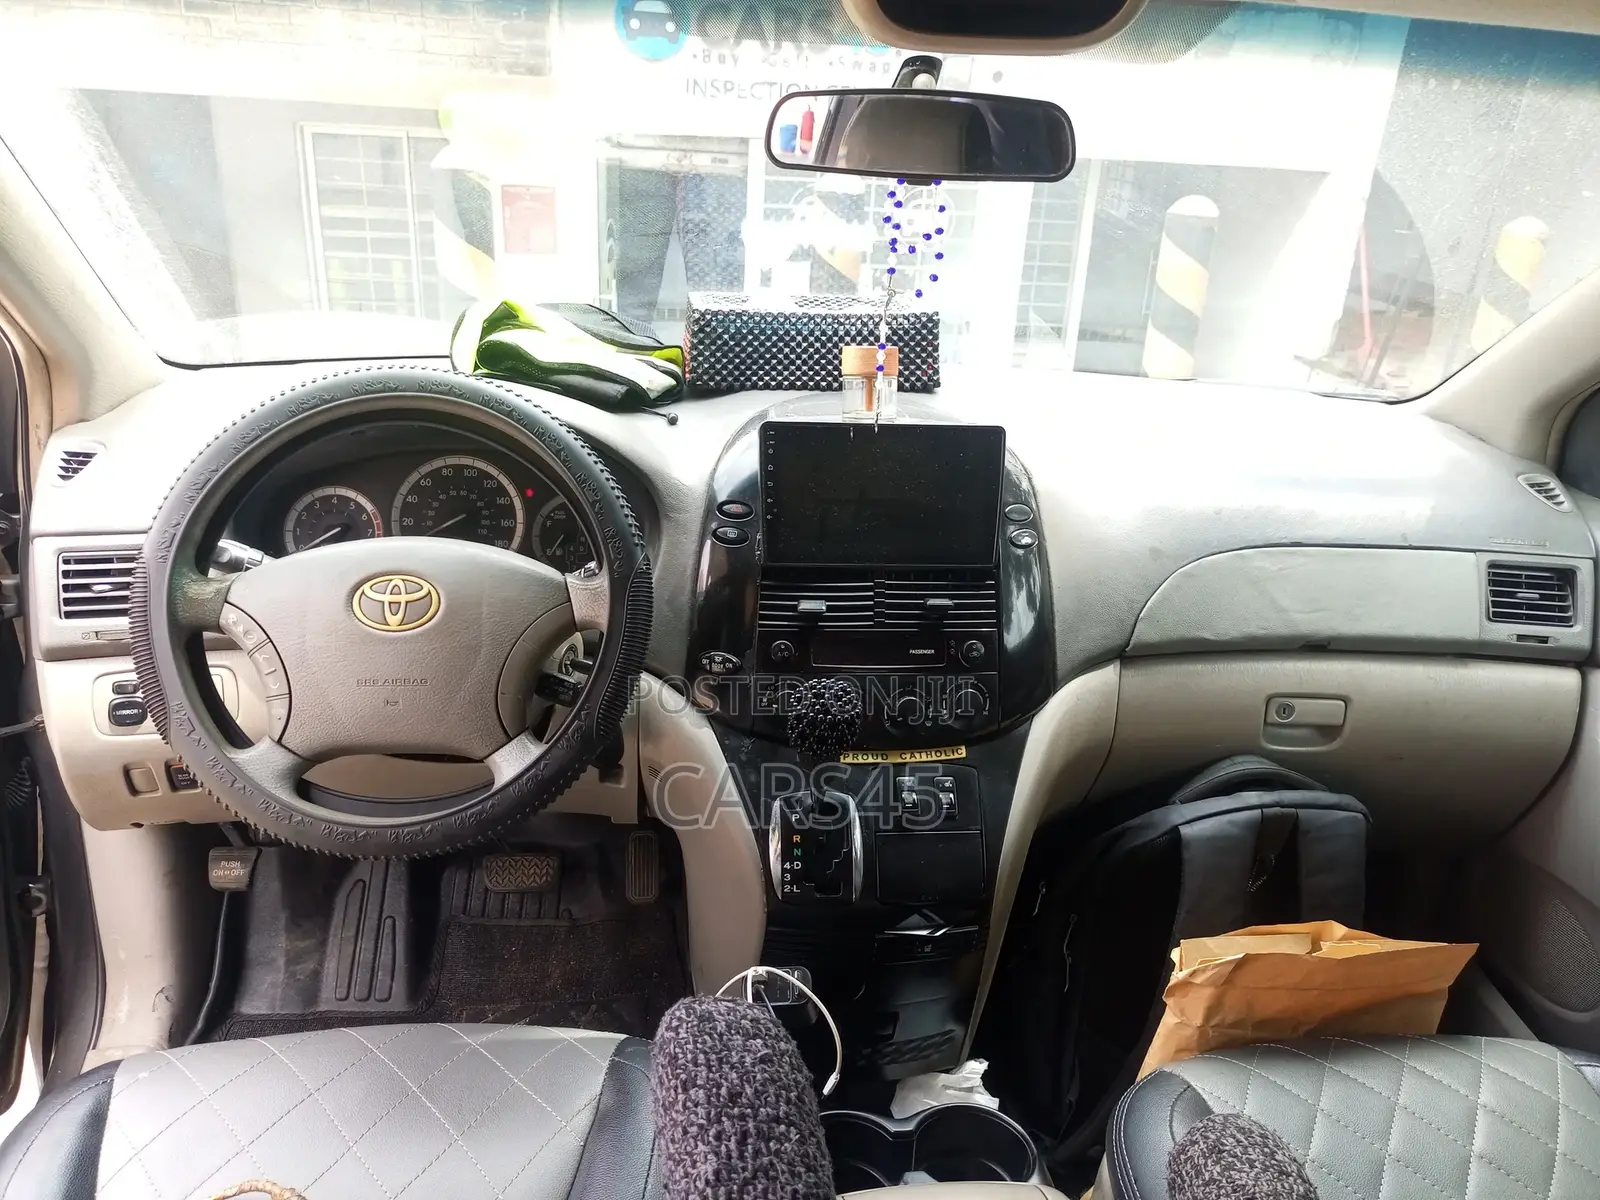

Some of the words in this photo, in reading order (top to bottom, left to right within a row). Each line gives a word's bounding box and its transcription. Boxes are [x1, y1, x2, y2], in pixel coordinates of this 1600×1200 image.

[441, 468, 453, 476] 80
[463, 469, 478, 477] 100
[420, 478, 432, 486] 60
[483, 480, 497, 488] 120
[406, 495, 418, 503] 40
[496, 497, 511, 505] 140
[314, 501, 320, 509] 3
[301, 512, 307, 520] 2
[402, 517, 414, 526] 20
[500, 519, 515, 527] 160
[367, 529, 373, 537] 7
[494, 540, 509, 548] 180
[115, 708, 139, 716] MIRROR
[842, 753, 889, 761] PROUD
[899, 747, 964, 761] CATHOLIC
[792, 813, 800, 822] P
[793, 834, 801, 843] R
[793, 848, 802, 856] N
[220, 860, 241, 868] PUSH
[783, 873, 791, 881] 3
